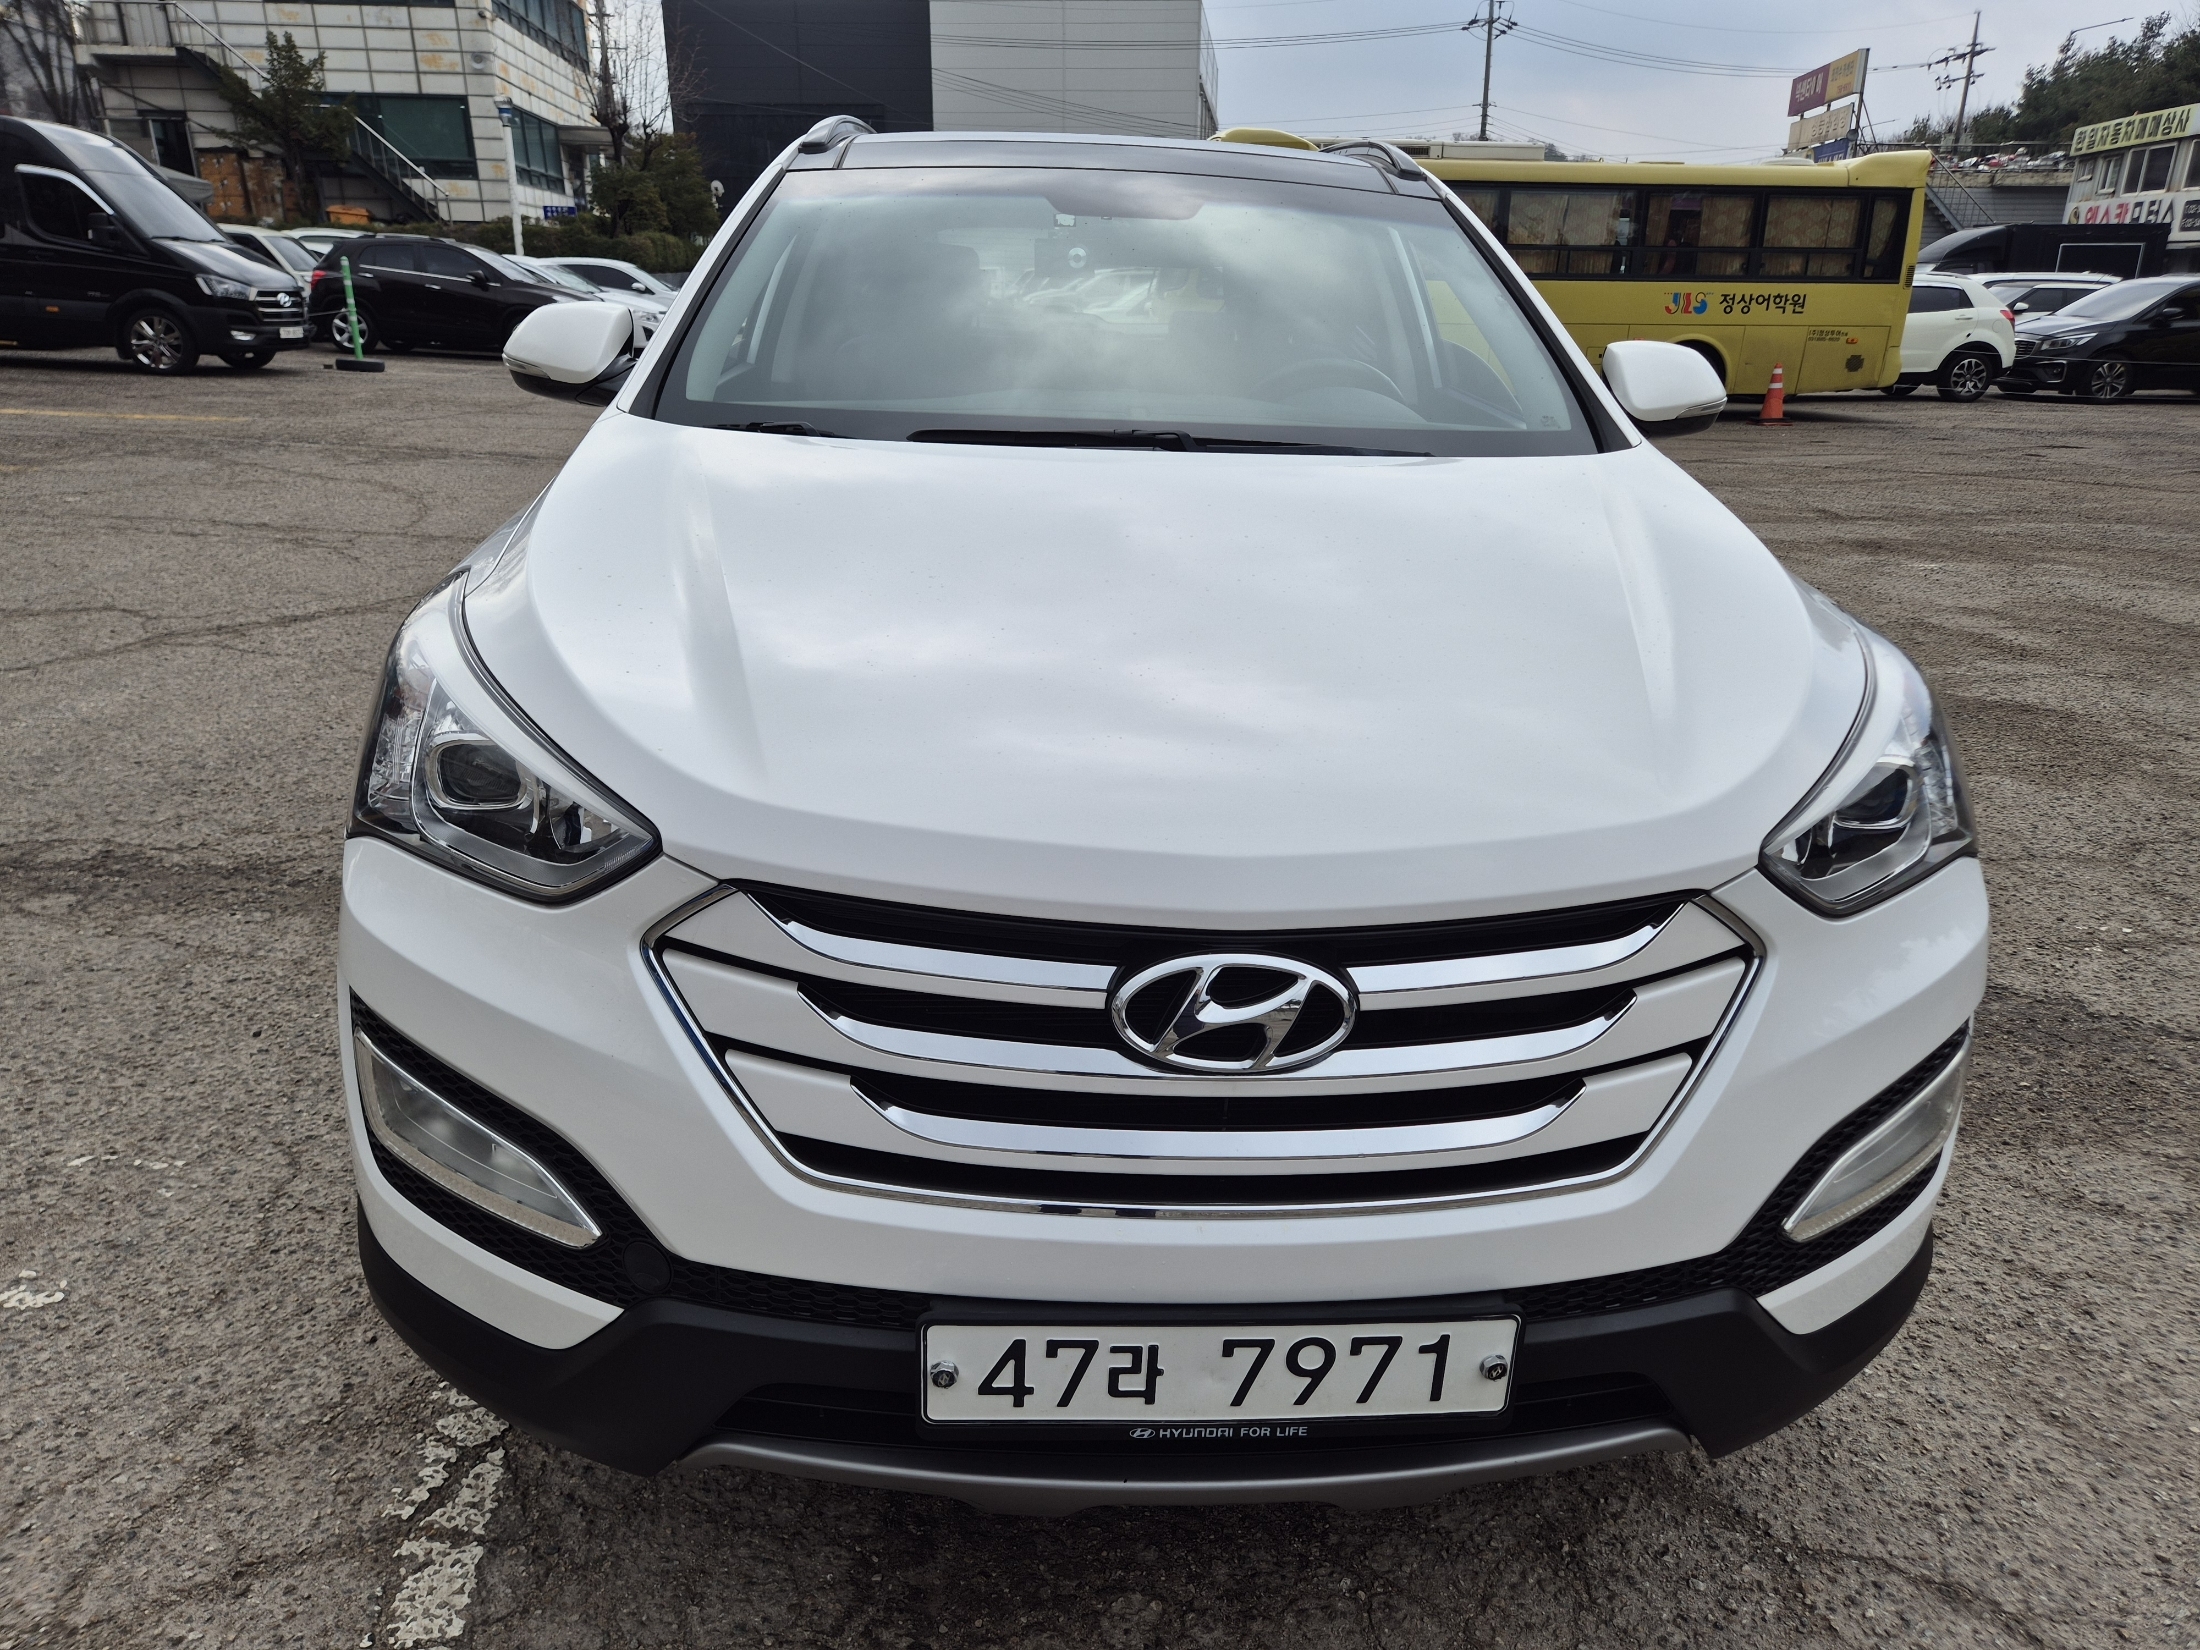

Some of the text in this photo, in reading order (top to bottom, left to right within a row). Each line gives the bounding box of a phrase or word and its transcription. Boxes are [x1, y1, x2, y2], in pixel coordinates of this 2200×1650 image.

[2074, 108, 2192, 152] 한일자동차매매상사
[1719, 292, 1807, 315] 정상어학원
[977, 1333, 1452, 1408] 47라 7971
[1159, 1426, 1308, 1438] HYUNDAI FOR LIFE
